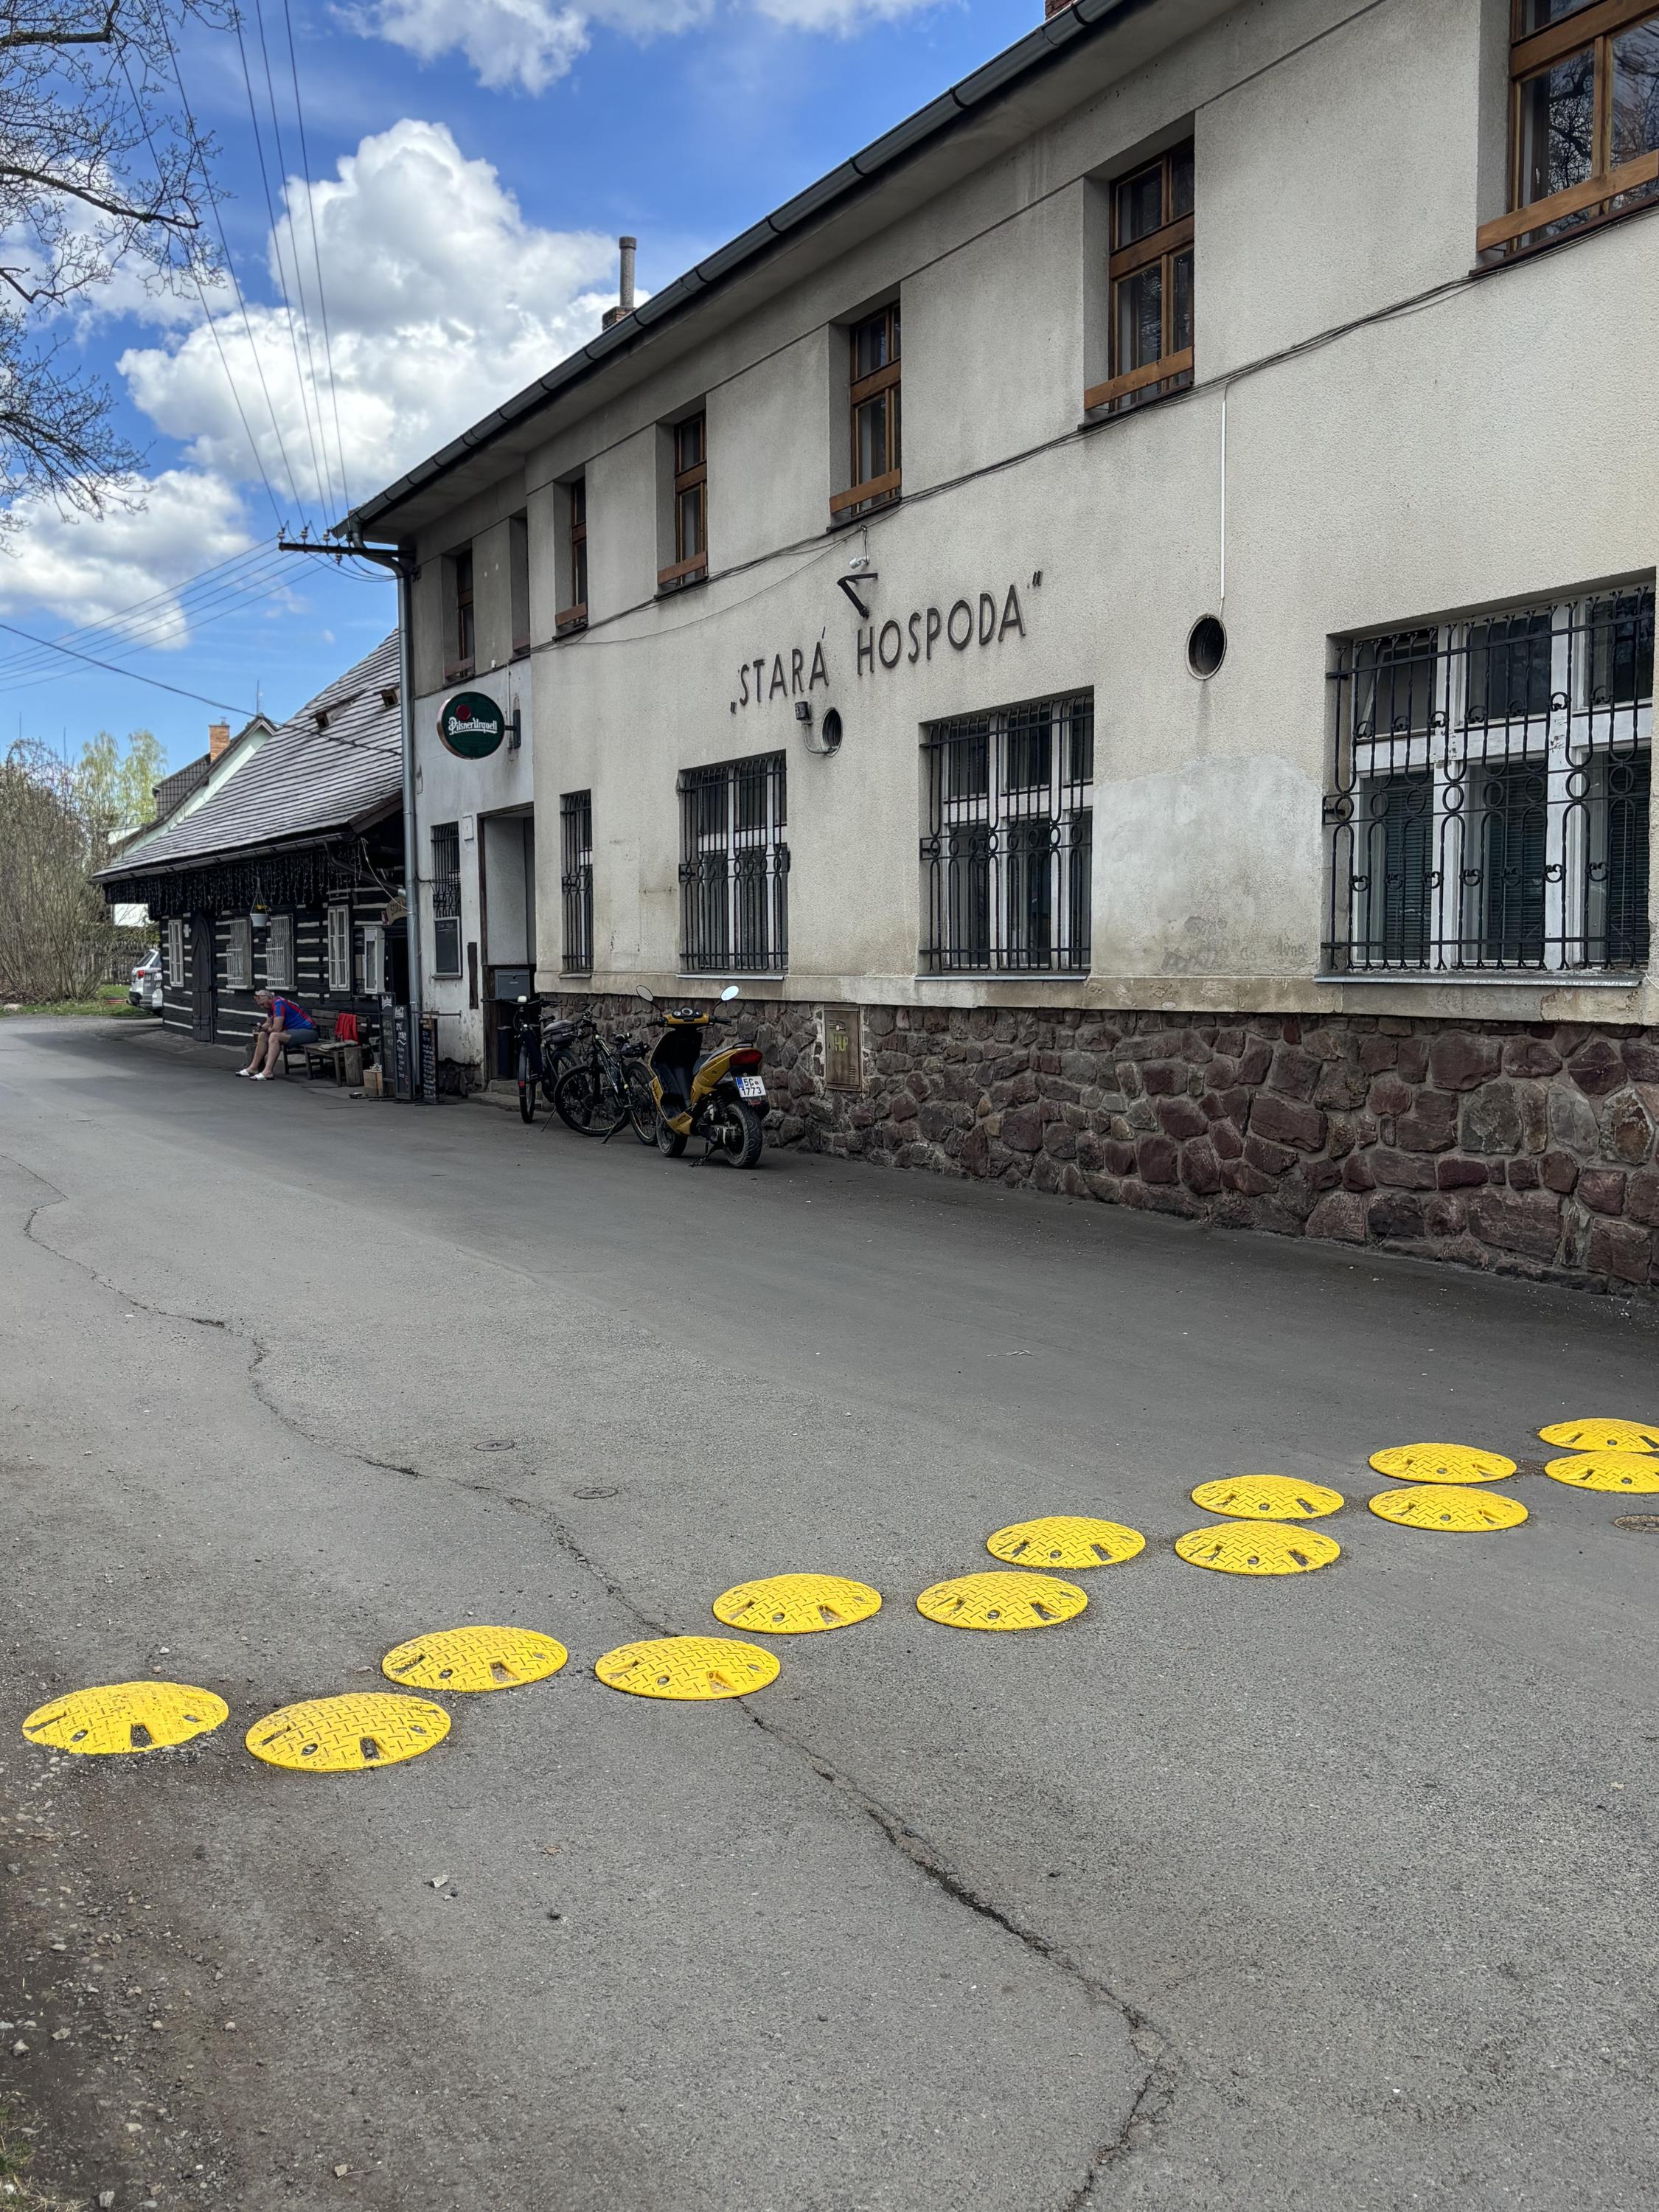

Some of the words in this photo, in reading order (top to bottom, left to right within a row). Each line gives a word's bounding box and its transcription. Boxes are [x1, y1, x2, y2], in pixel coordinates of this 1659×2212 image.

[448, 716, 473, 735] Pilsner
[473, 717, 497, 734] Urquell
[835, 1035, 849, 1051] HUP
[743, 1078, 754, 1087] 5C
[741, 1087, 762, 1096] 1773
